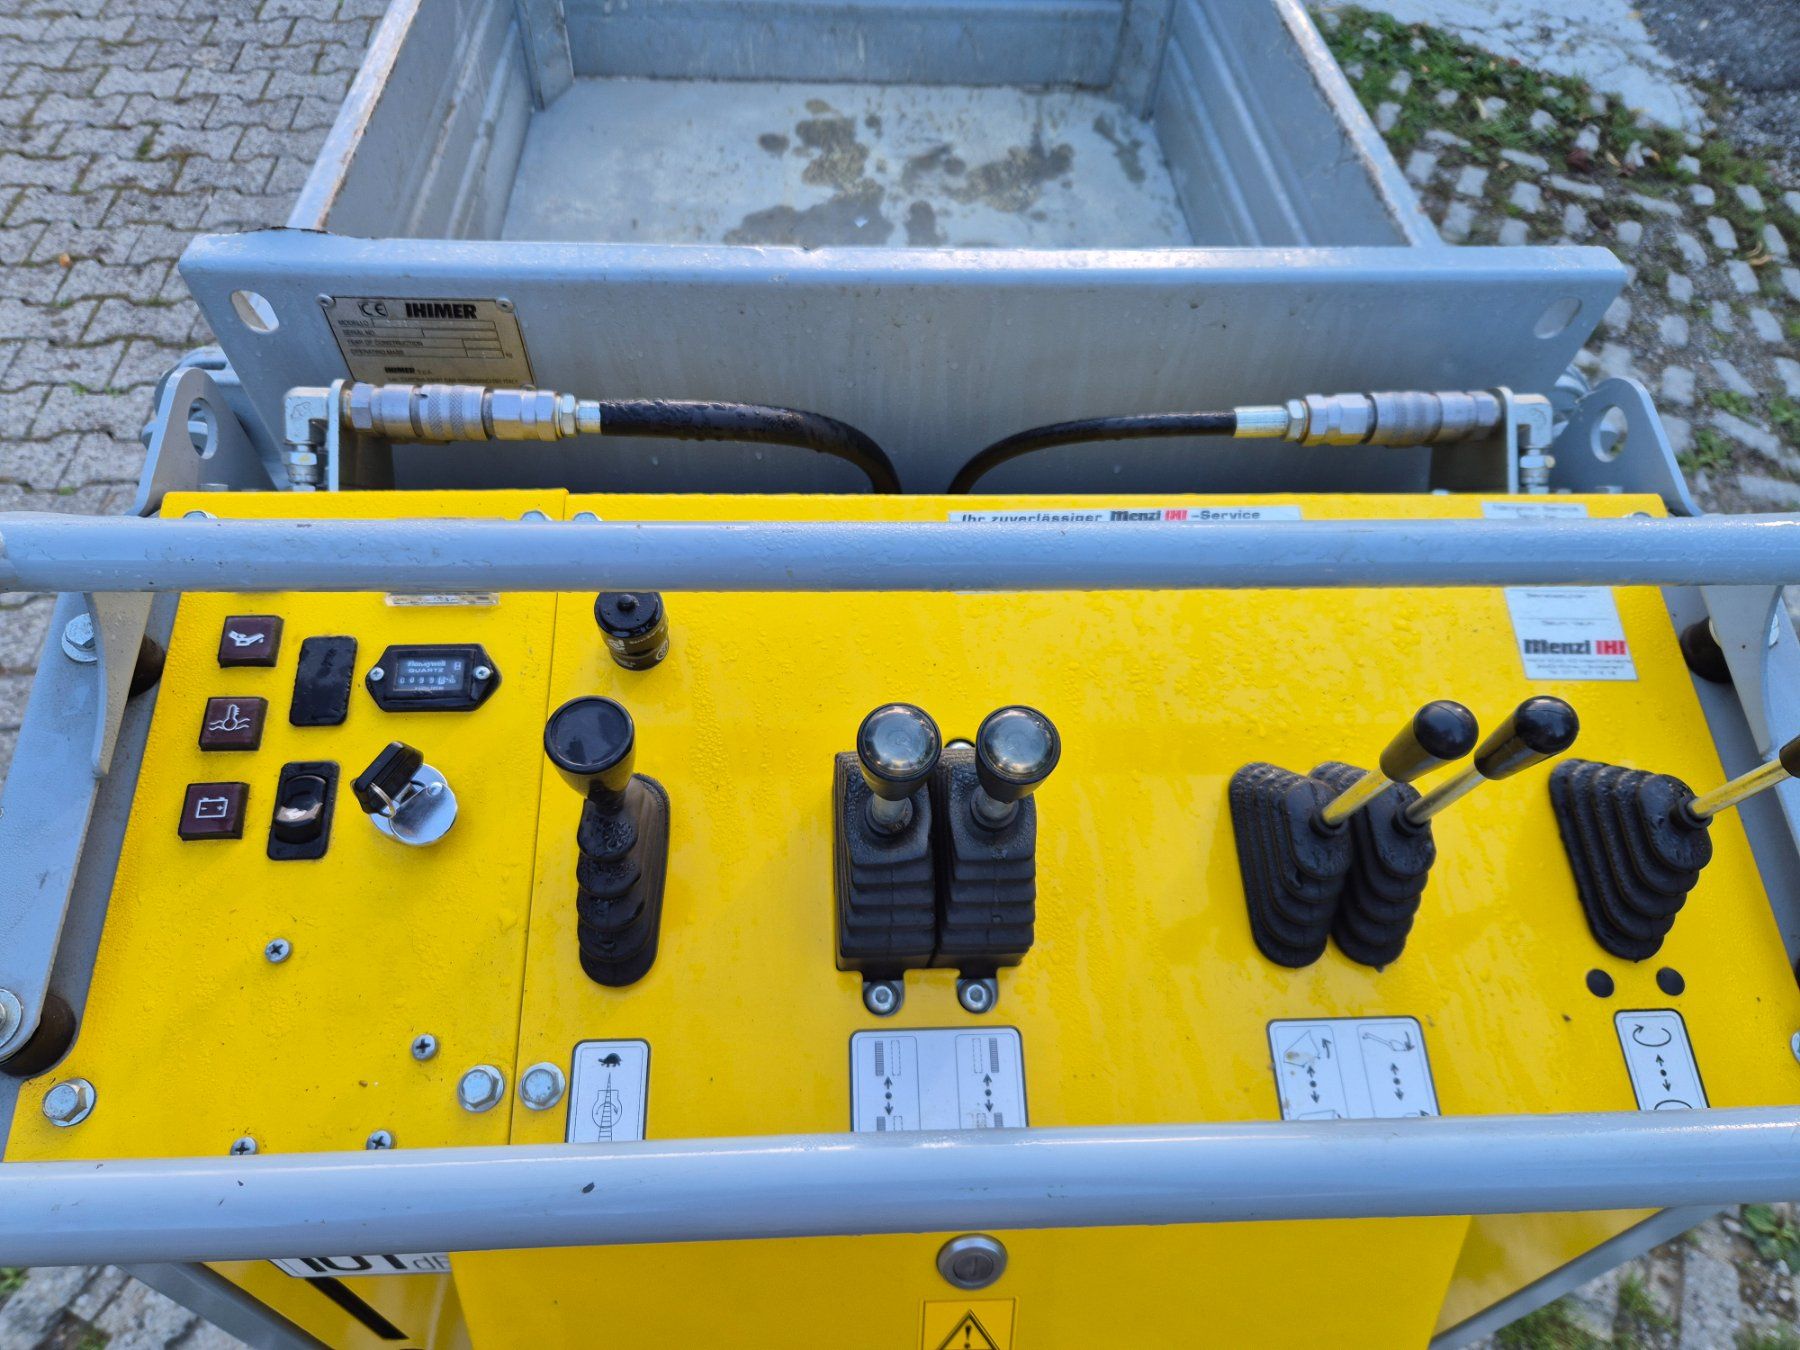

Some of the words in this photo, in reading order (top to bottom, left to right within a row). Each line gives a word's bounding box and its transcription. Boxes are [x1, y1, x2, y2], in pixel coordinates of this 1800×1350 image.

[405, 303, 477, 319] IHIMER
[962, 513, 986, 522] Ihr
[1523, 639, 1591, 655] Menzi
[1596, 640, 1627, 655] IHI
